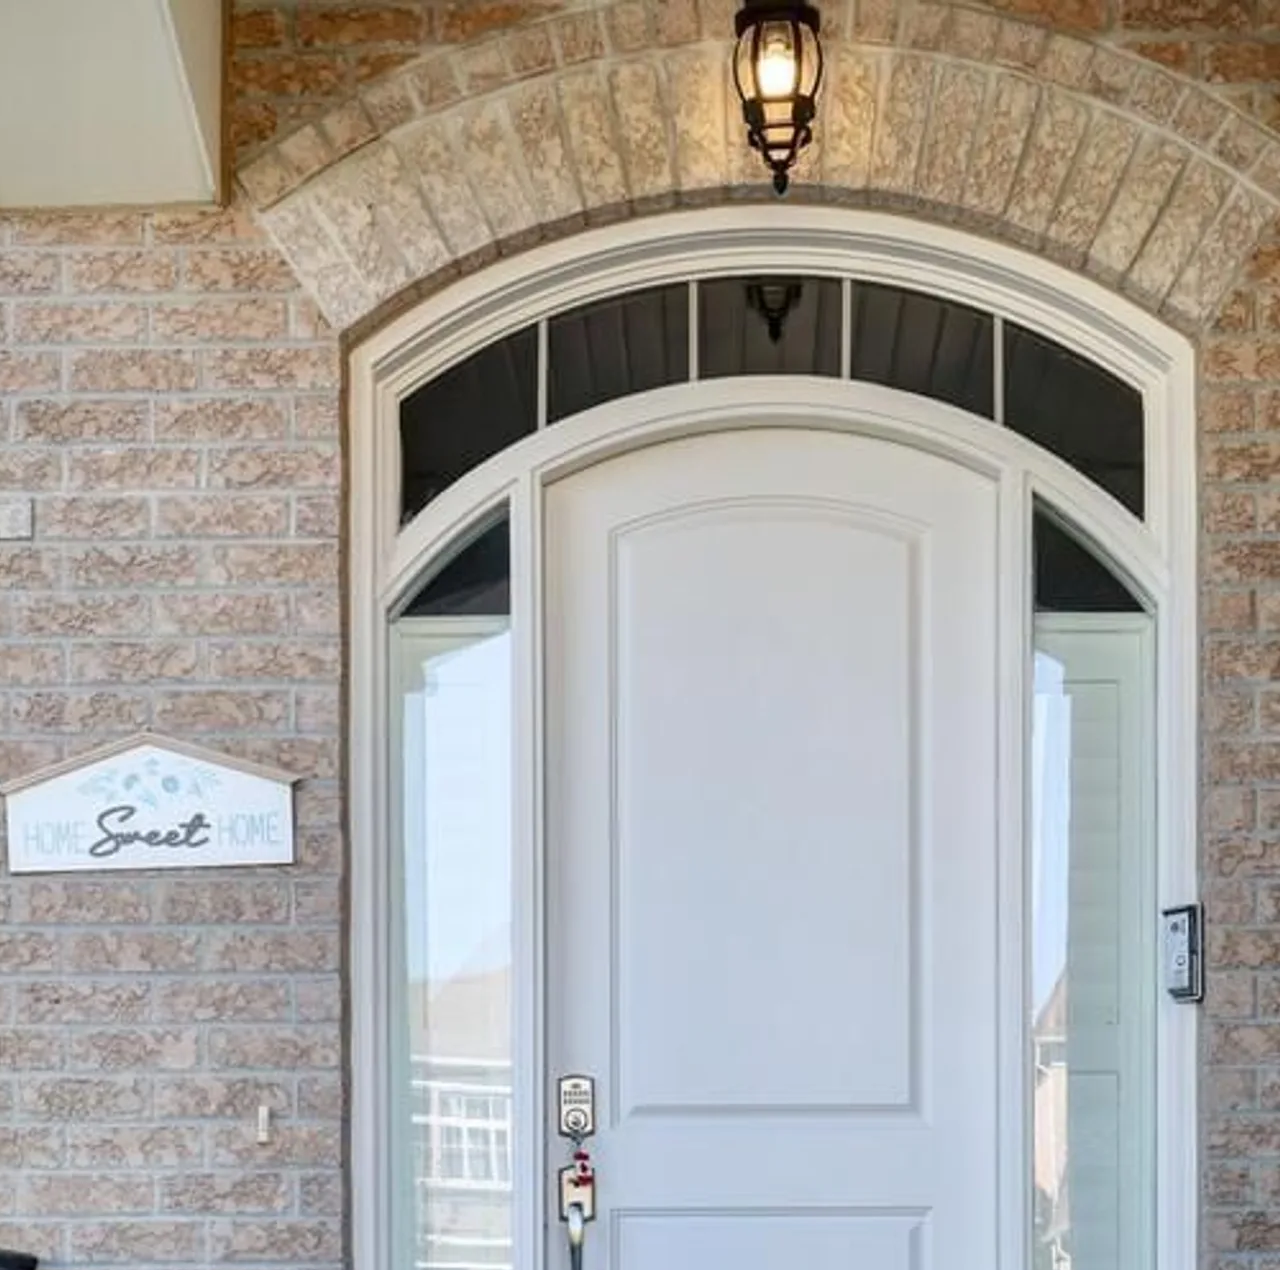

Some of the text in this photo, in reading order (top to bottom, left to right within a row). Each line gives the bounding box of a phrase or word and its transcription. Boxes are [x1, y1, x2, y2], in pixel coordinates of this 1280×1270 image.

[23, 805, 280, 857] HOME Sweet HOME
